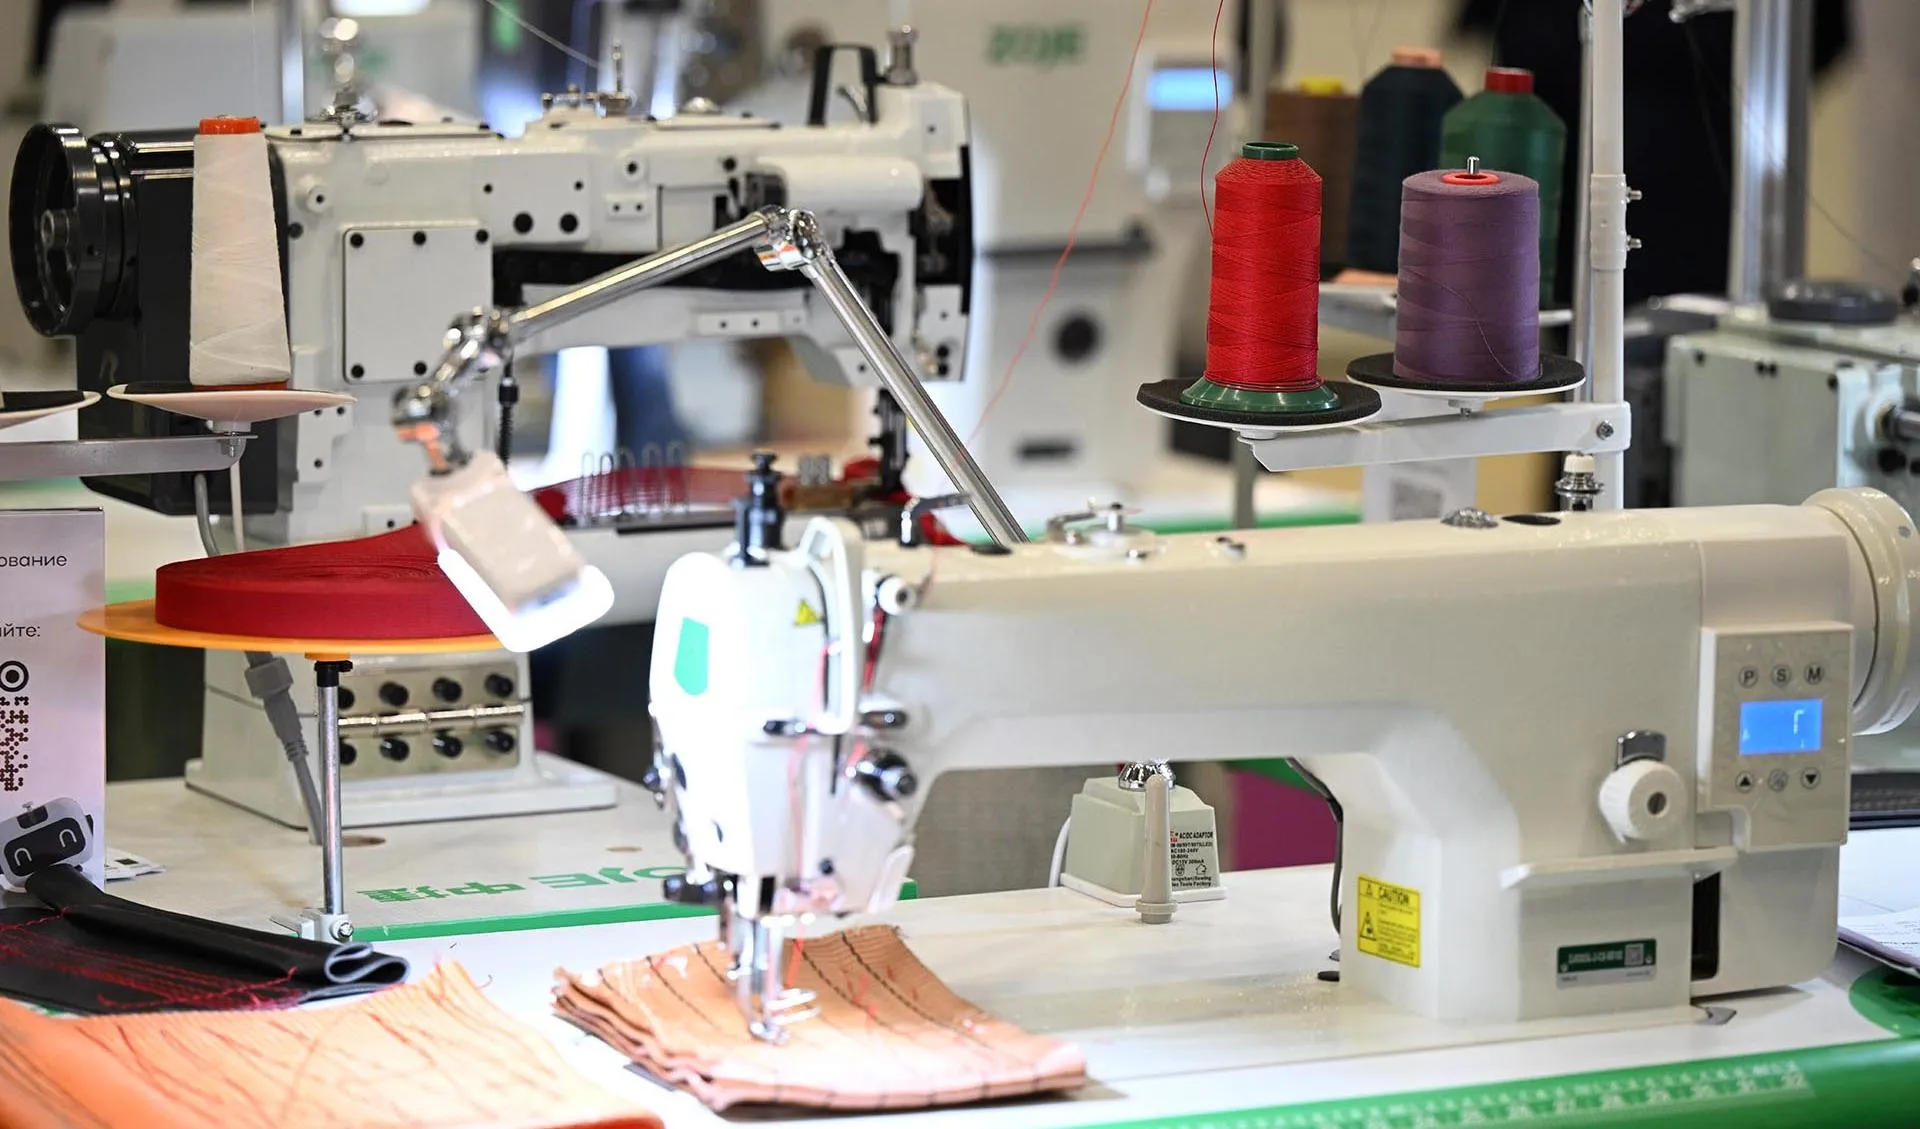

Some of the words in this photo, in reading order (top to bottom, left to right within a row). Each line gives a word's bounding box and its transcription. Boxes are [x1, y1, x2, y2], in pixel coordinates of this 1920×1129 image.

[0, 622, 41, 637] йте:
[1743, 670, 1755, 684] P
[1776, 668, 1787, 682] S
[1807, 667, 1821, 681] M
[529, 866, 692, 889] OJE
